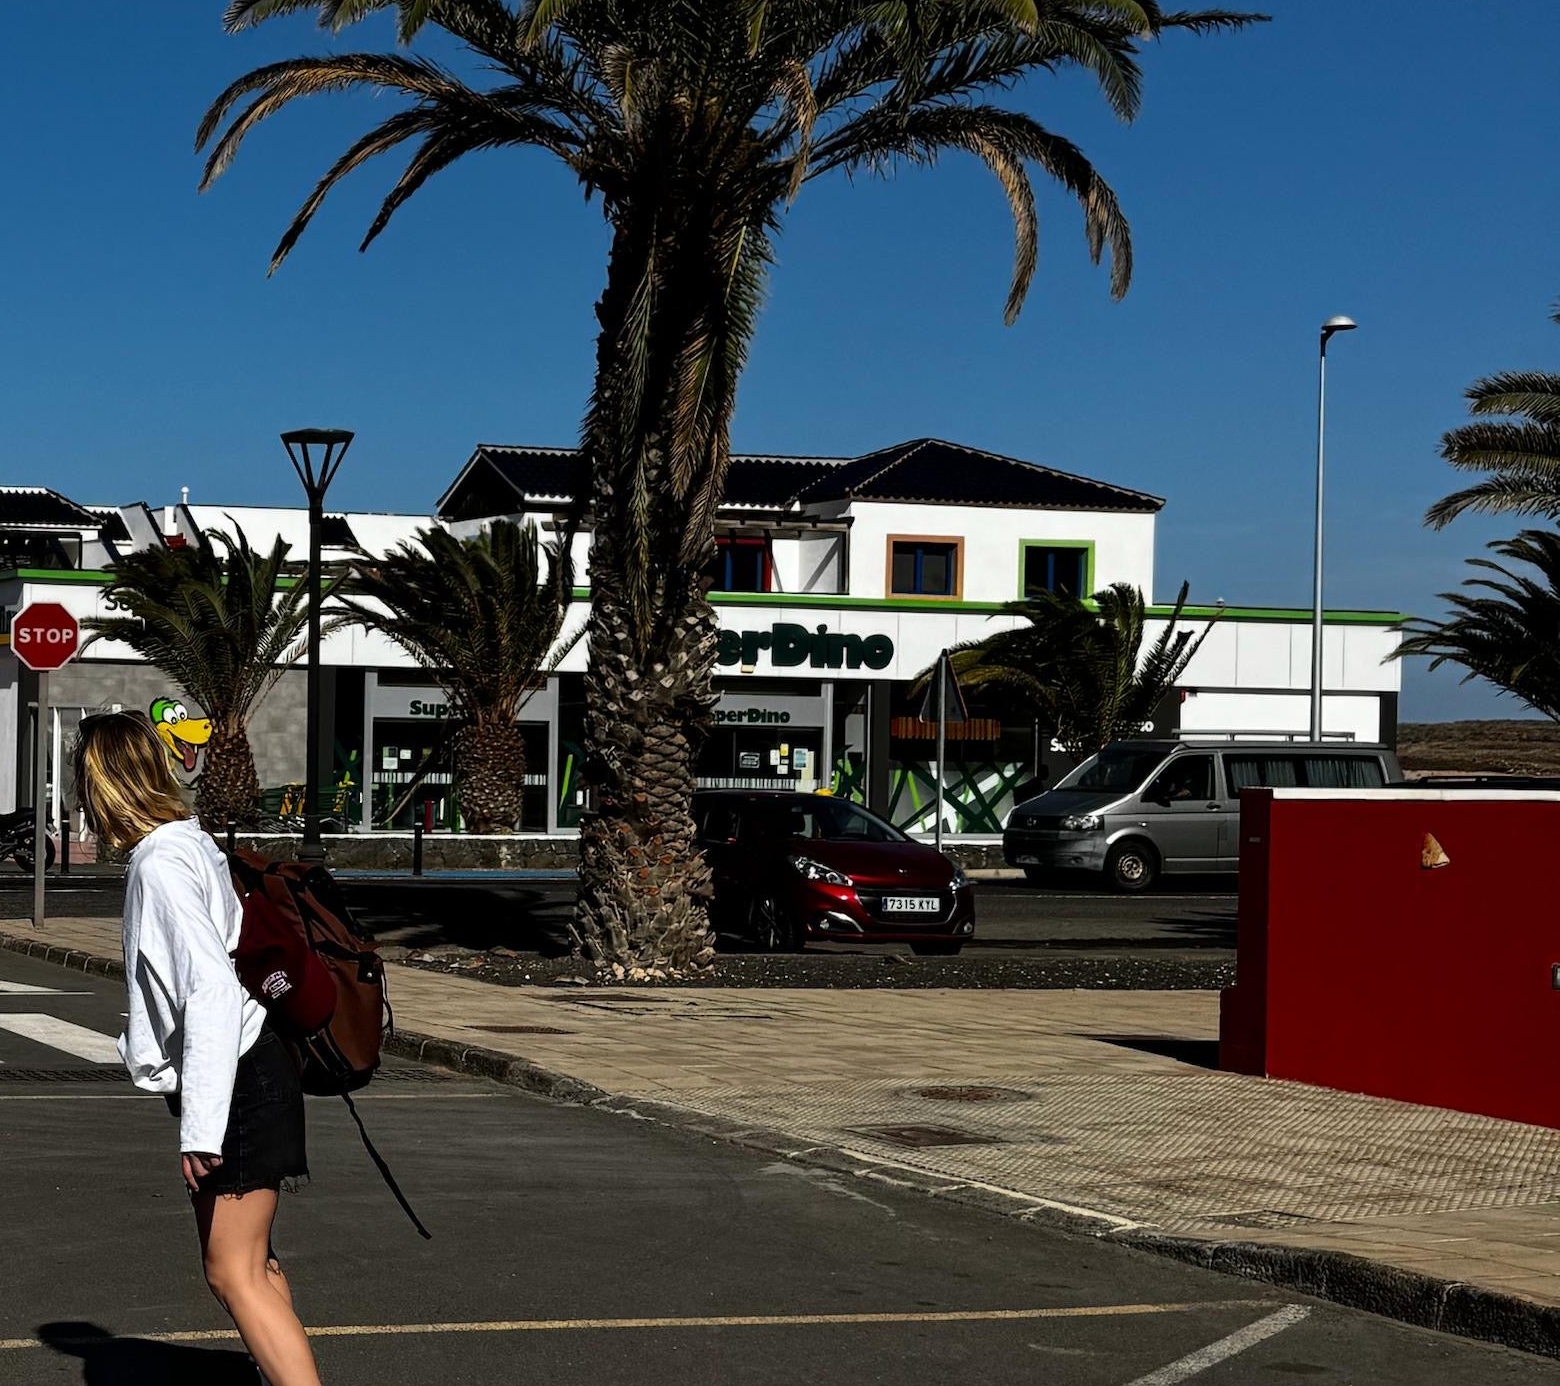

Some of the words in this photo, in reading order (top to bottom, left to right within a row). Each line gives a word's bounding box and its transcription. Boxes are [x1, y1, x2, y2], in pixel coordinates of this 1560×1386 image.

[18, 627, 74, 644] STOP
[715, 623, 894, 670] erDino
[409, 700, 450, 719] Sup
[712, 708, 790, 725] perDino
[889, 899, 915, 910] 7315
[918, 899, 937, 910] KYL
